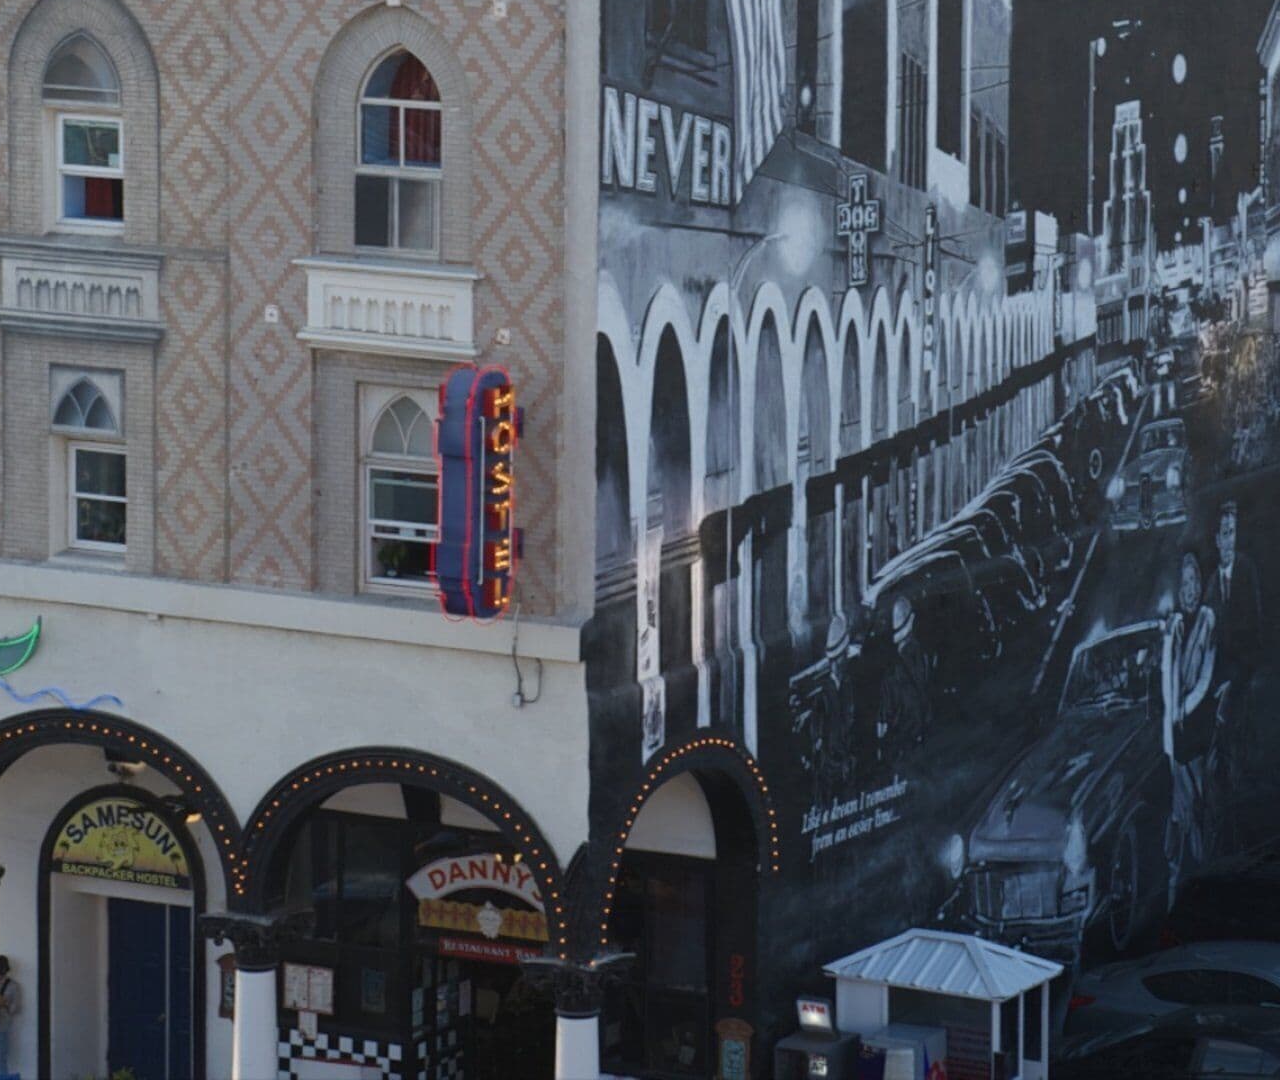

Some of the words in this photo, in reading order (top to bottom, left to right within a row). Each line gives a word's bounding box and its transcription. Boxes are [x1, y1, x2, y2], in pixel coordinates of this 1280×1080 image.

[601, 85, 732, 207] NEVER
[487, 385, 515, 608] HOSTEL
[65, 804, 178, 857] SAMESUN
[801, 806, 822, 835] Like
[61, 862, 135, 882] BACKPACKER
[135, 872, 178, 889] HOSTEL
[427, 859, 544, 903] DANNY
[801, 1003, 827, 1016] ATM
